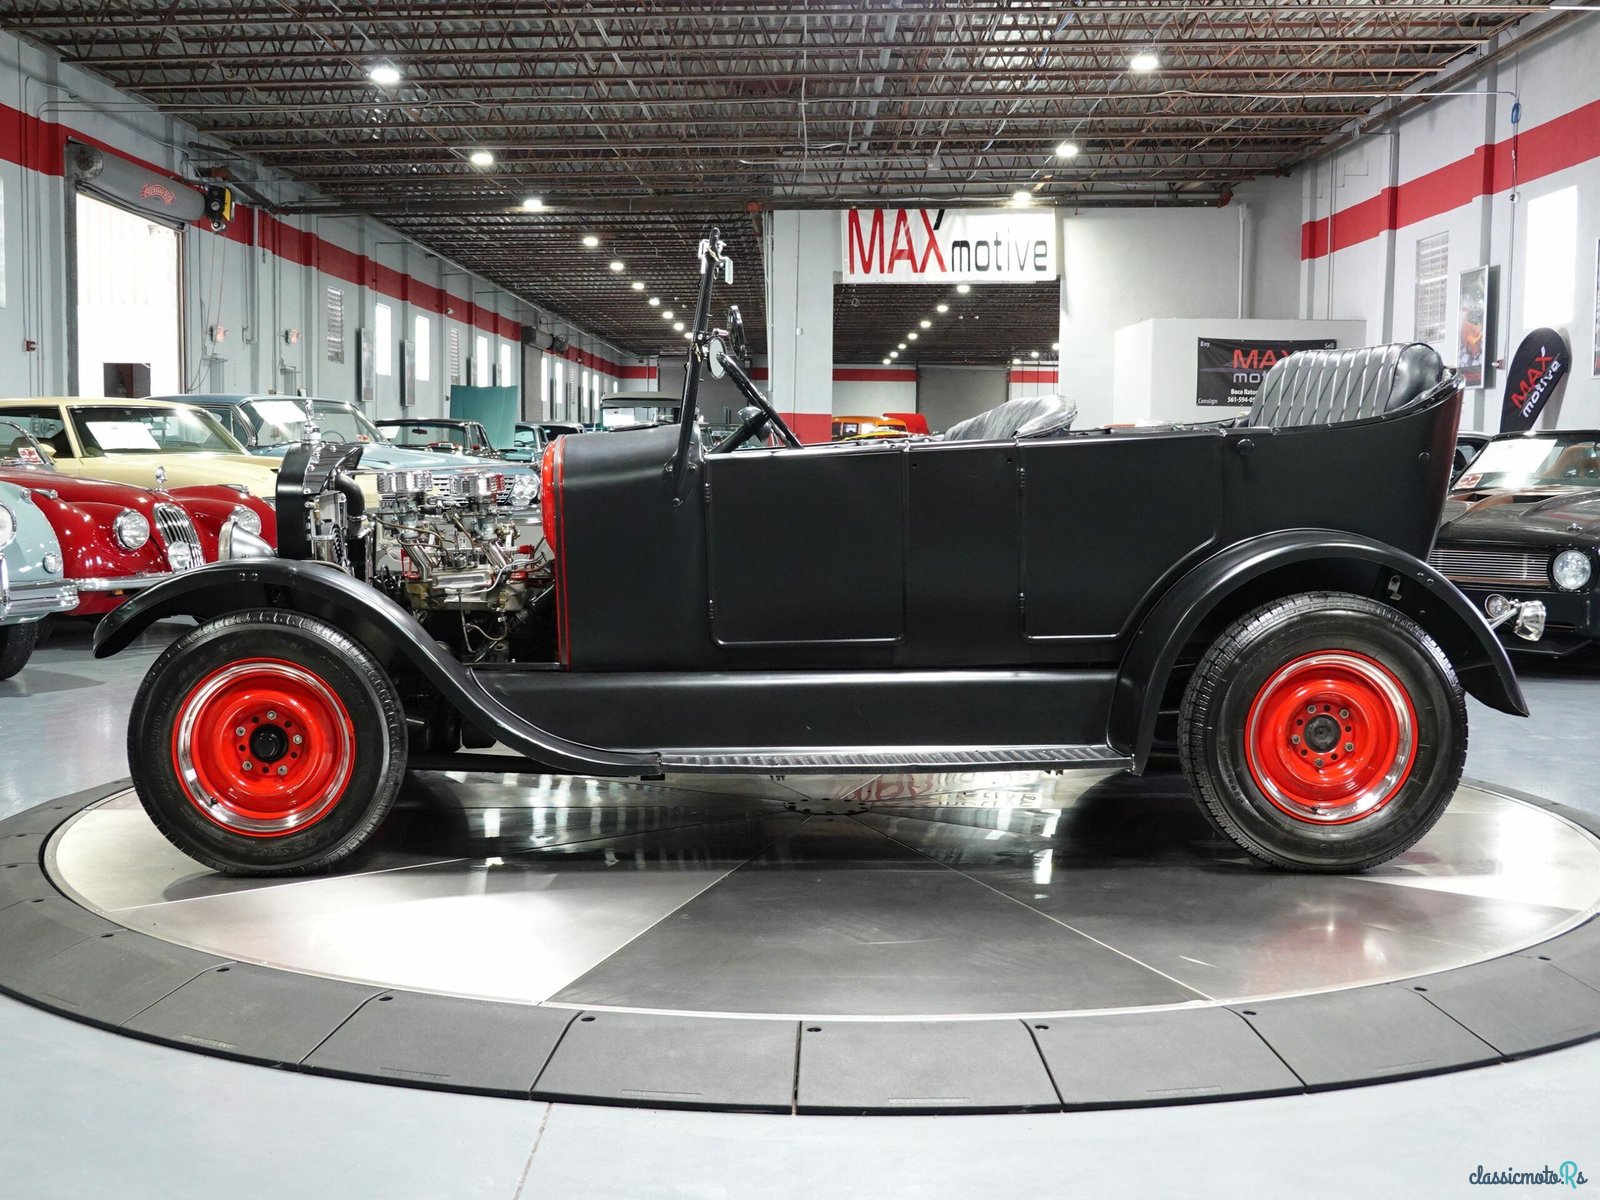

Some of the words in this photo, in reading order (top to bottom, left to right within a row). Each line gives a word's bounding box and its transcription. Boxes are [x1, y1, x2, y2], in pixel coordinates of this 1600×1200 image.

[848, 208, 947, 274] MAX
[952, 227, 1048, 272] motive
[1232, 349, 1290, 369] MA
[1511, 346, 1553, 409] MAX
[1522, 360, 1561, 418] motive
